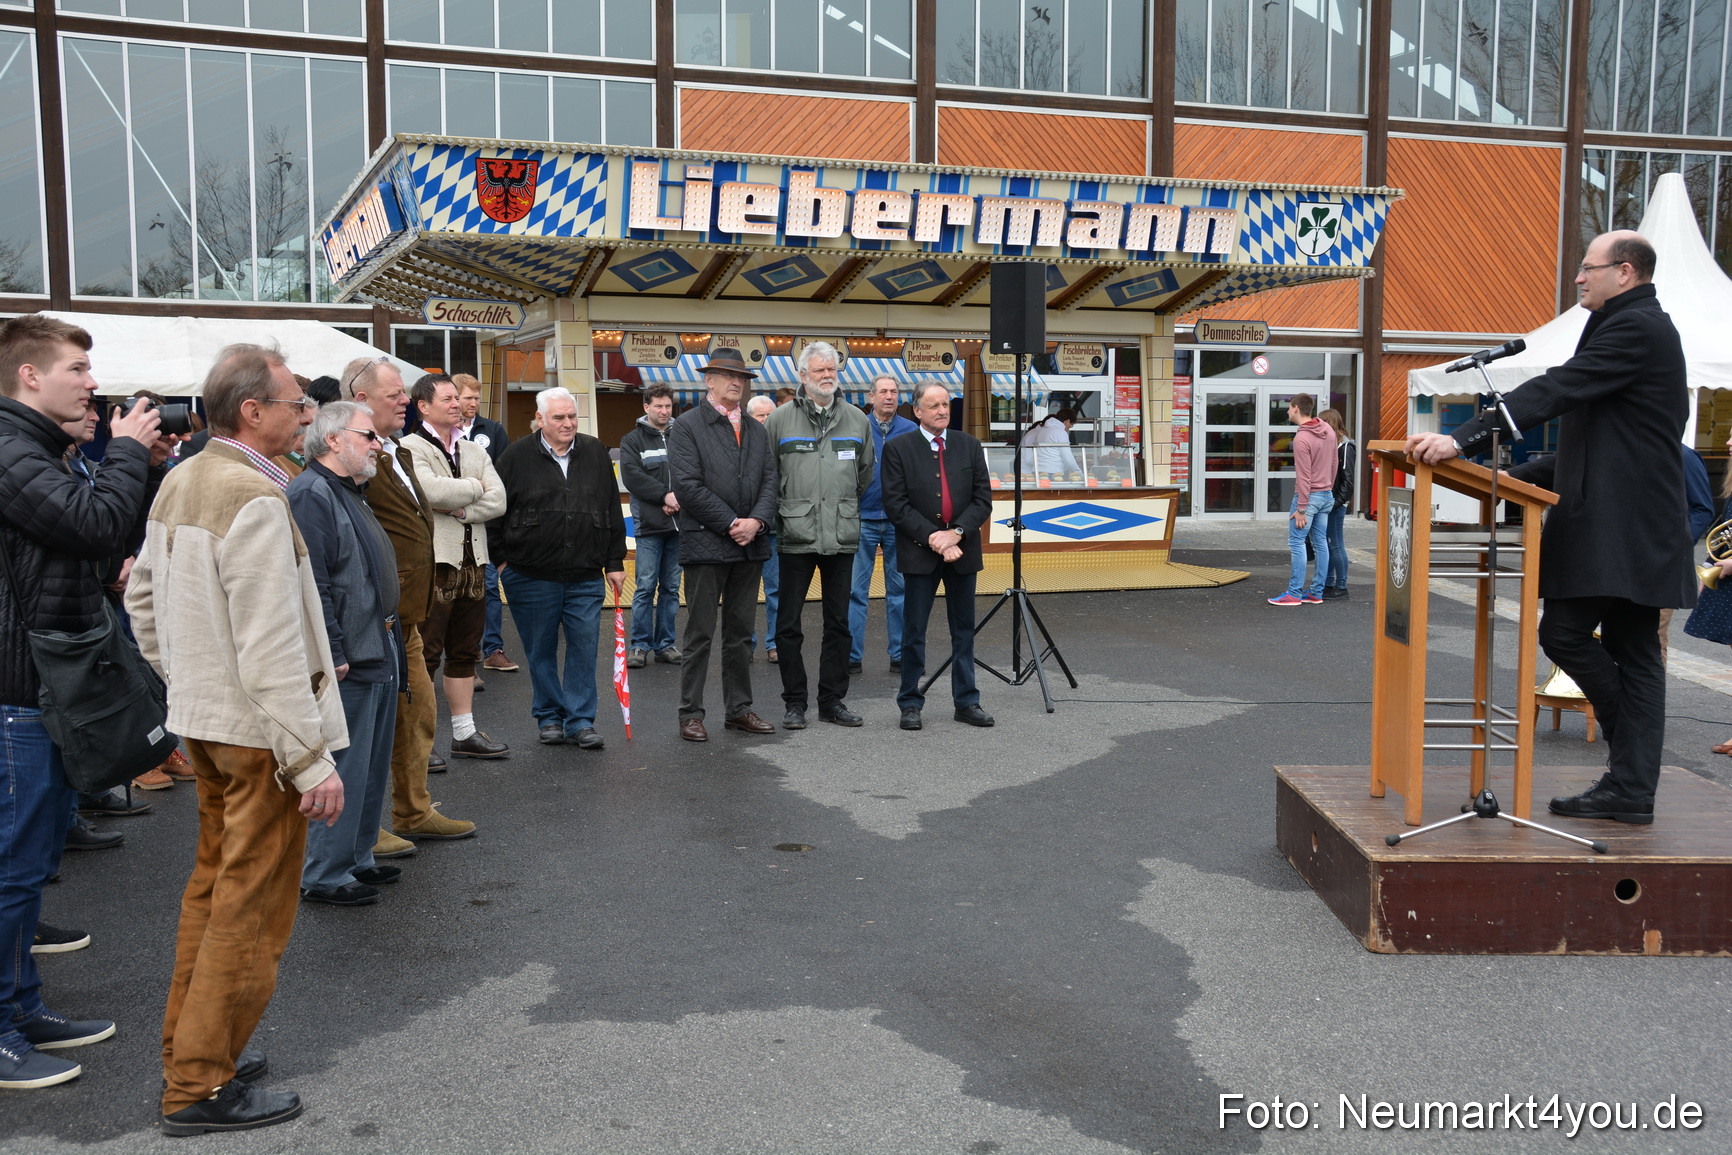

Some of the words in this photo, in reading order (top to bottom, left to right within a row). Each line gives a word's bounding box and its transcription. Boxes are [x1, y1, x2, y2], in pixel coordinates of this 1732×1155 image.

[628, 159, 1238, 254] Liebermann
[433, 302, 515, 325] Schaschlik
[1203, 323, 1264, 342] Pommesfrites
[631, 333, 667, 346] Frikadelle
[717, 334, 740, 347] Steak
[915, 341, 932, 351] Paar
[1063, 344, 1101, 355] Fischbrötchen
[908, 351, 941, 362] Bratwürste
